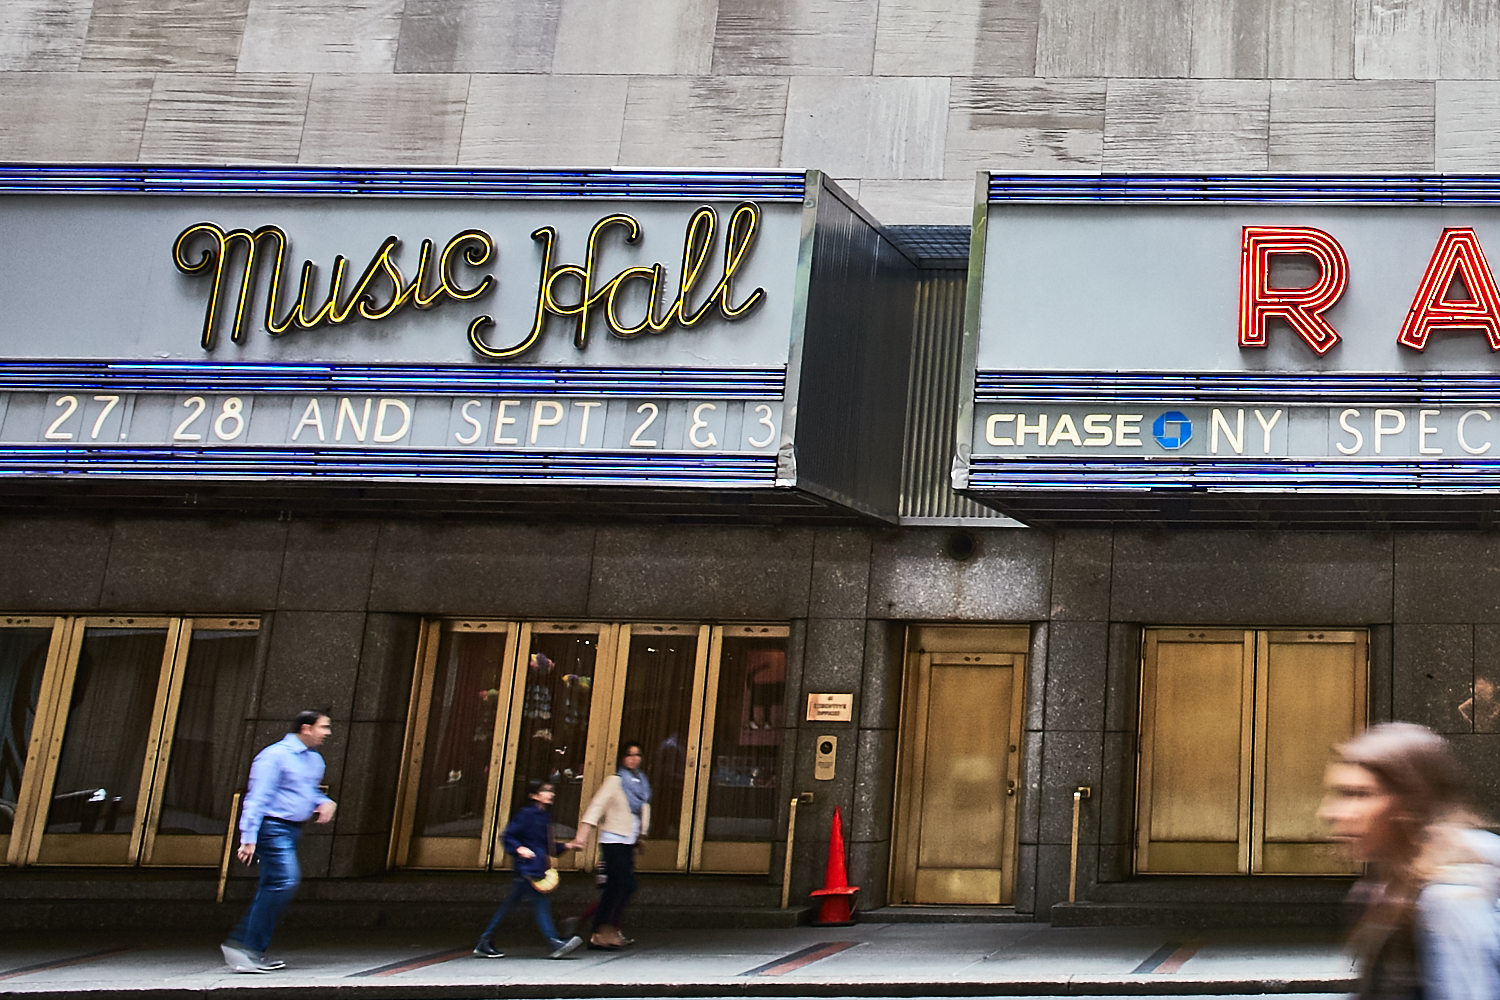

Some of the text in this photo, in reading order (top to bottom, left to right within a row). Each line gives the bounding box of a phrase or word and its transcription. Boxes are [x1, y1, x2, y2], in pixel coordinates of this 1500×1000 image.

[172, 200, 765, 358] Music Hall
[172, 396, 245, 441] 28
[291, 397, 411, 443] AND
[454, 399, 602, 445] SEPT
[628, 402, 660, 447] 2
[688, 403, 718, 448] &
[748, 404, 776, 448] 3
[985, 413, 1144, 447] CHASE
[1211, 408, 1283, 454] NY
